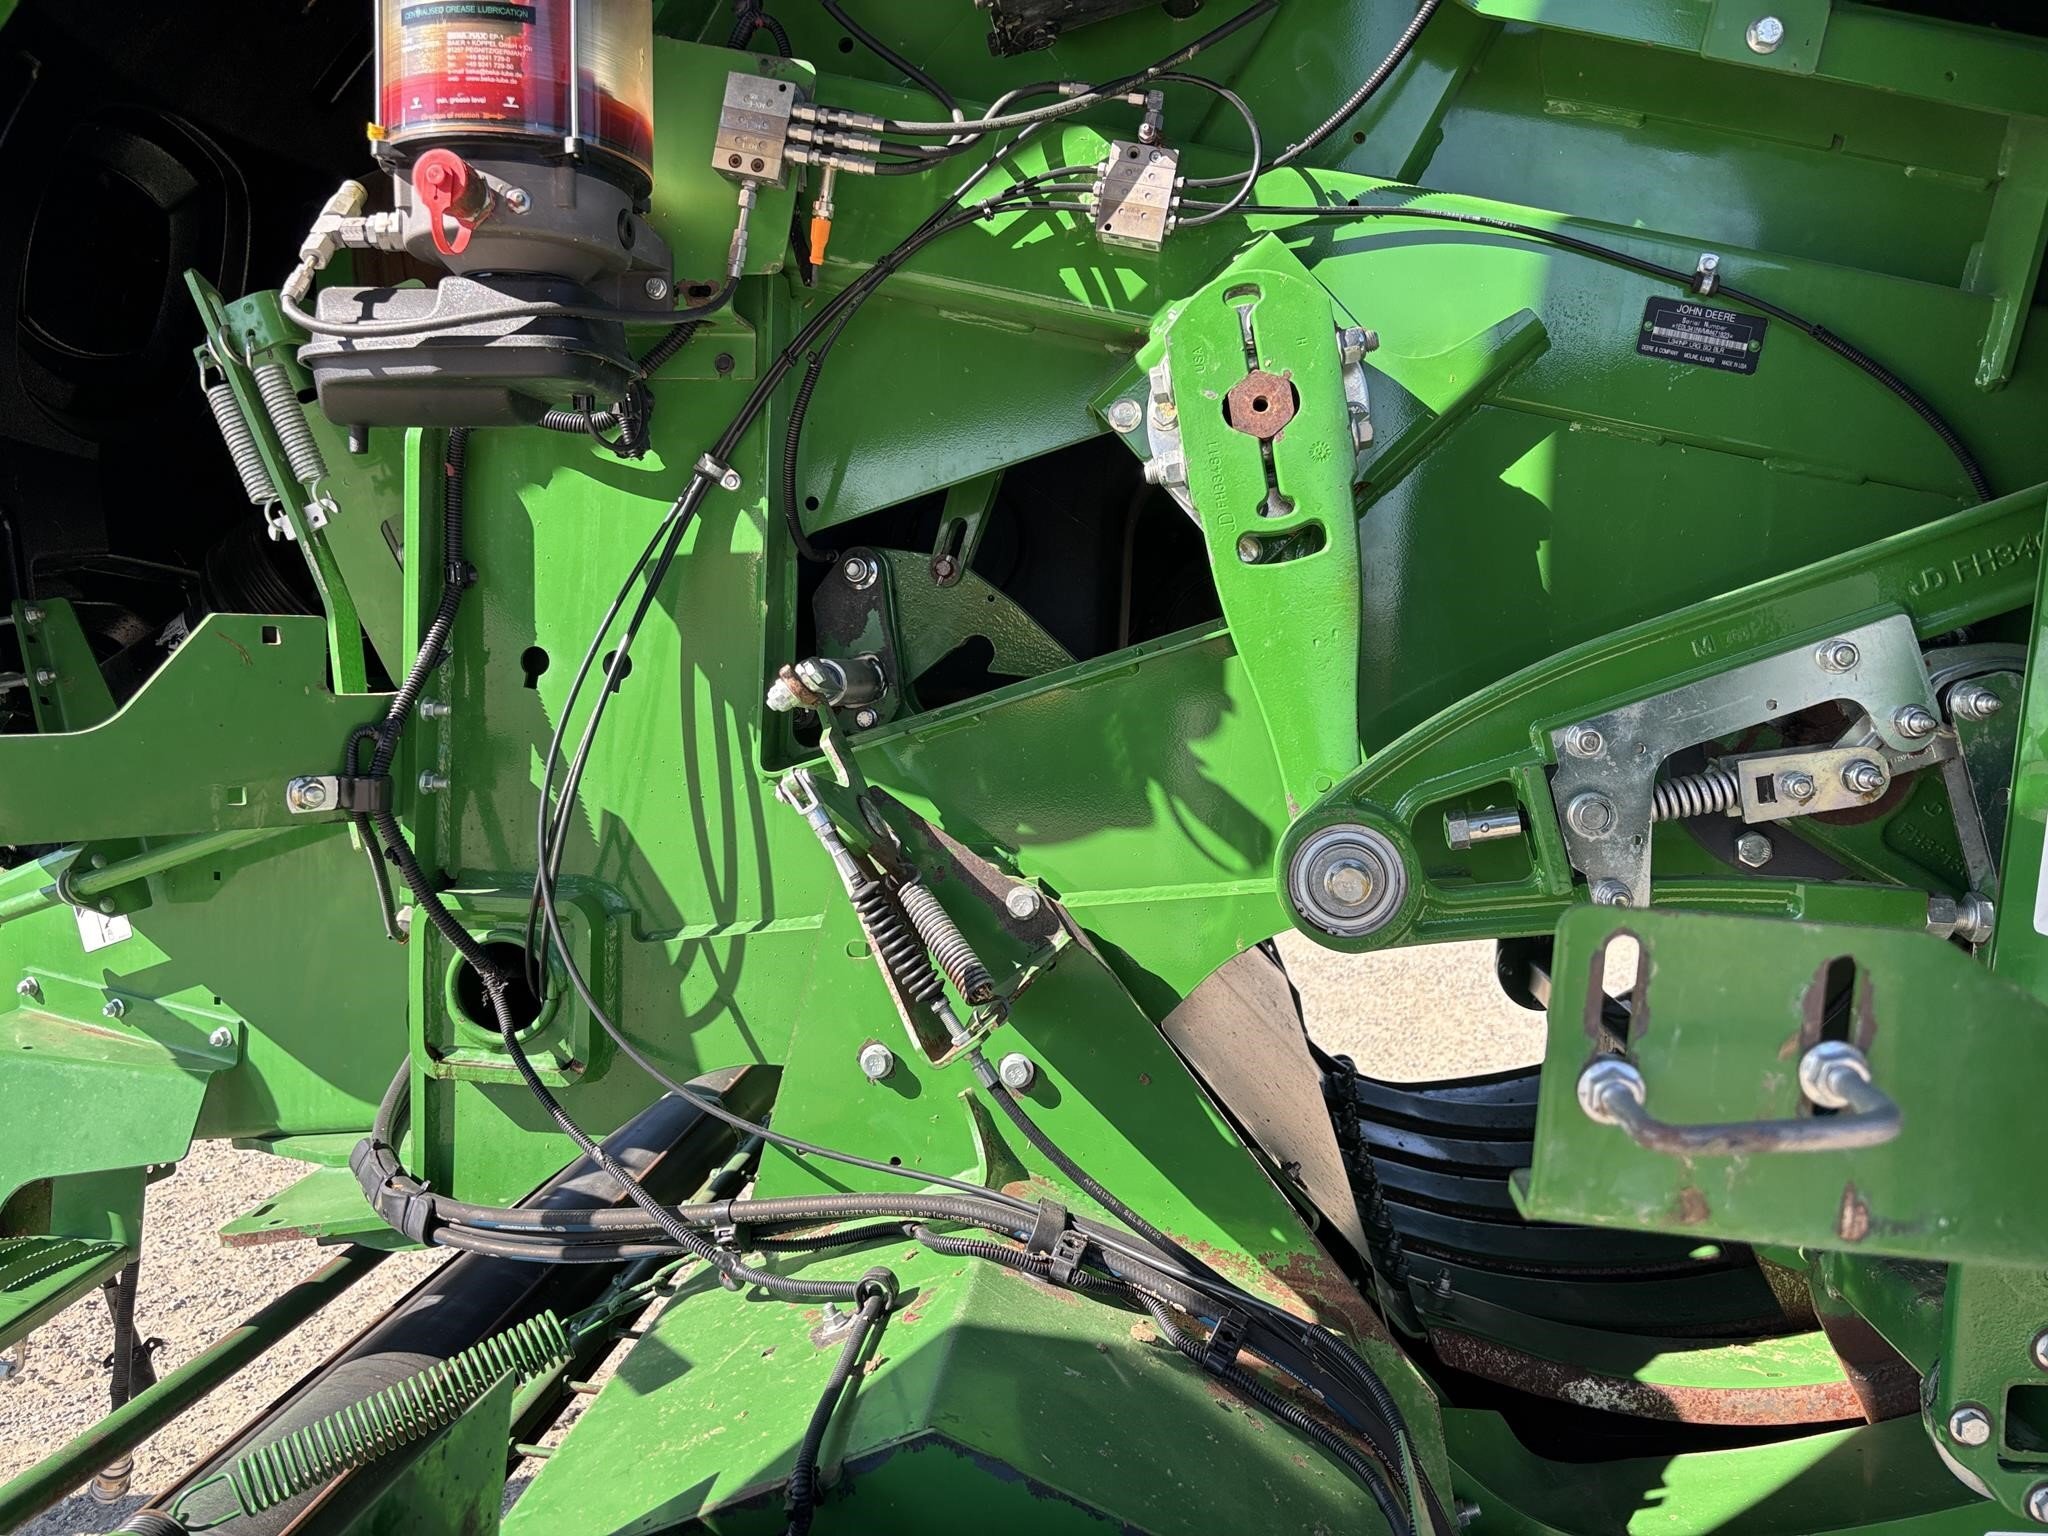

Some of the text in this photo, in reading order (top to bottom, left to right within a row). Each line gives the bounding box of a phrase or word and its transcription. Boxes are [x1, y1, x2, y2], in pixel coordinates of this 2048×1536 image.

[446, 5, 475, 13] GREASE
[478, 6, 529, 18] LUBRICATION
[1676, 304, 1737, 323] JOHN DEERE
[1682, 317, 1728, 332] Serial Number
[1641, 344, 1655, 352] DEERE
[1658, 347, 1680, 356] COMPANY
[1192, 346, 1207, 374] USA
[1908, 565, 1948, 600] JD
[973, 1219, 991, 1229] MPa
[991, 1223, 1010, 1234] 22.5
